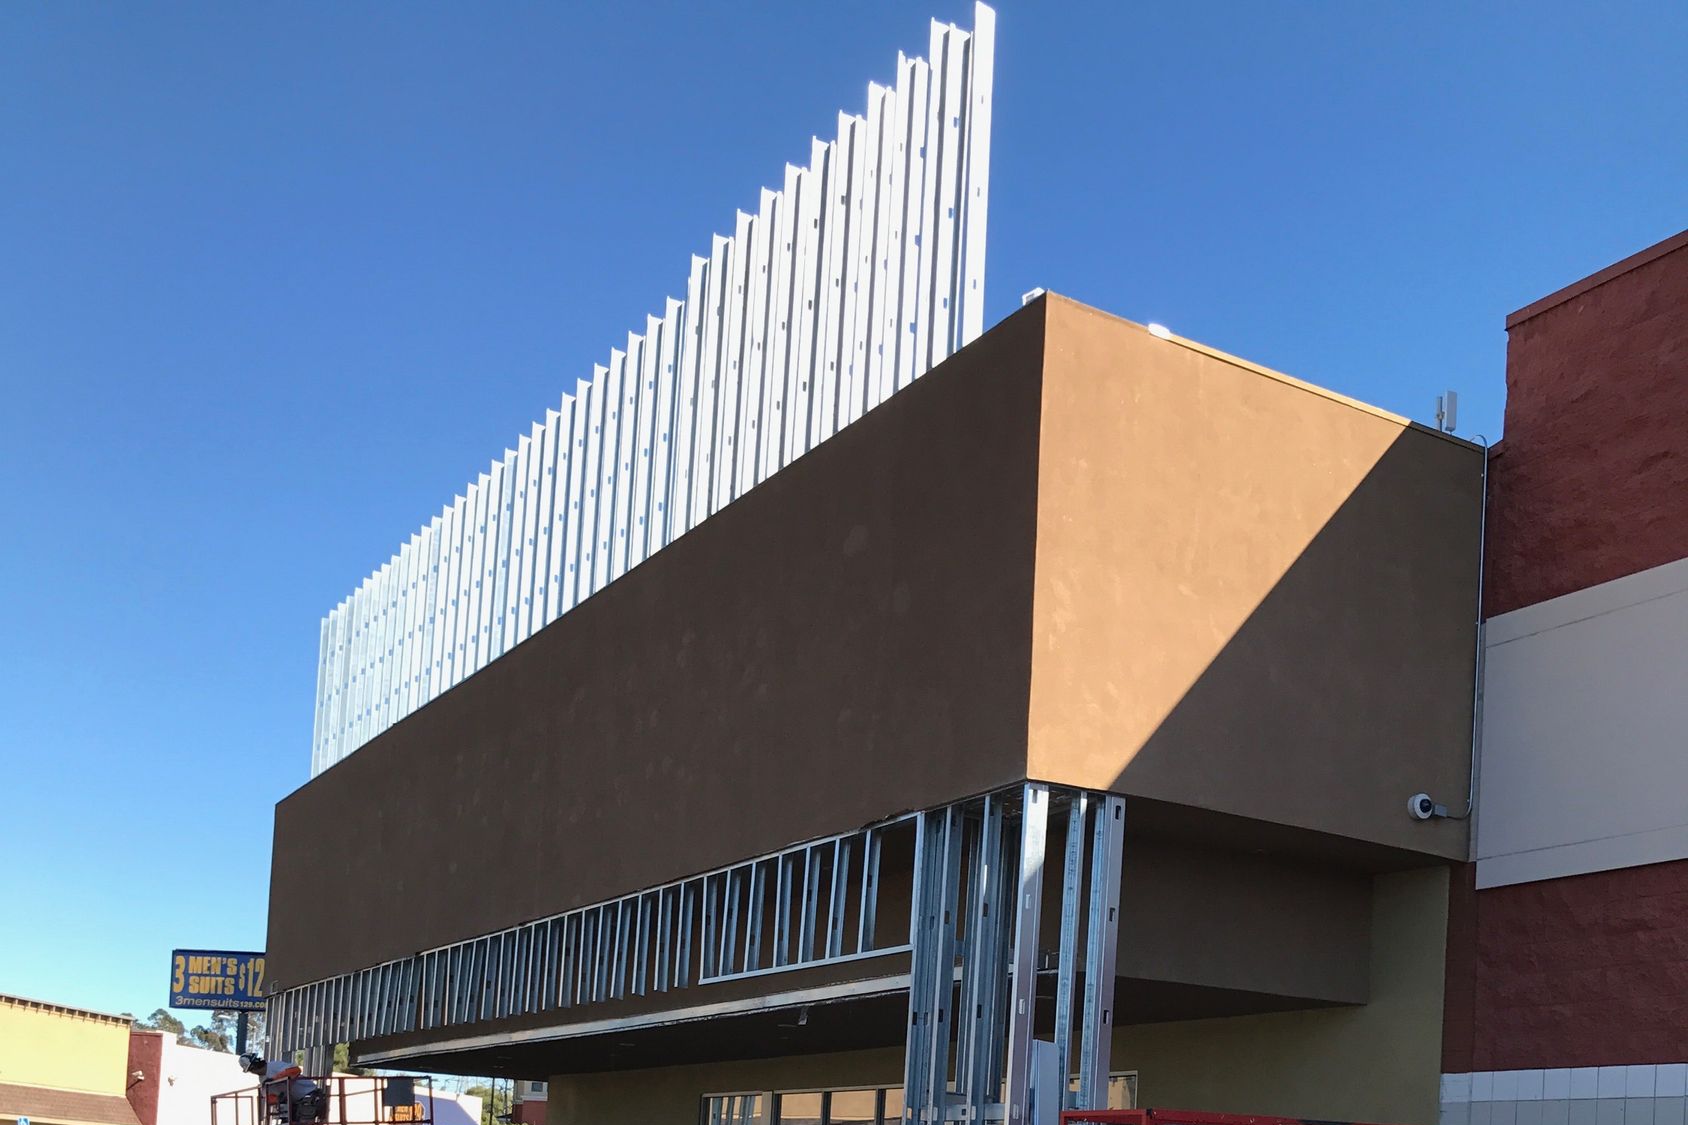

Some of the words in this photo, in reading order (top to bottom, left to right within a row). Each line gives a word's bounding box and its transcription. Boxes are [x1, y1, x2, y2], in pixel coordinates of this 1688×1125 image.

[173, 955, 185, 993] 3
[188, 956, 238, 975] MEN'S
[238, 958, 265, 997] $12
[188, 976, 235, 995] SUITS
